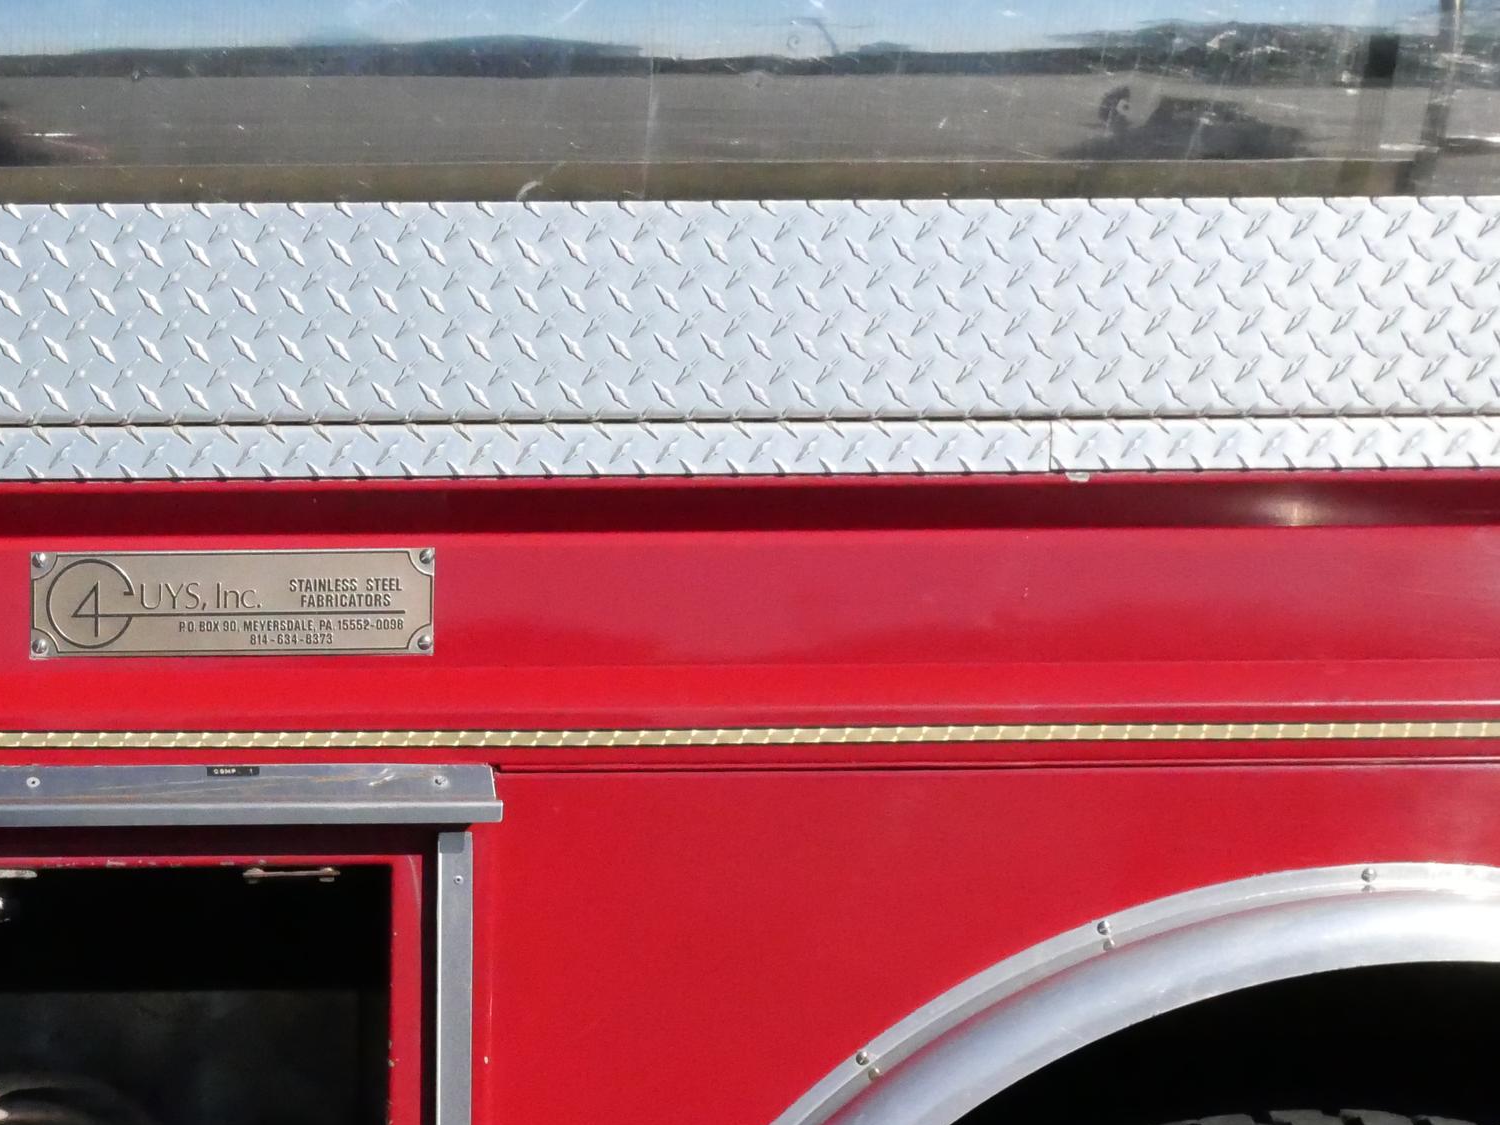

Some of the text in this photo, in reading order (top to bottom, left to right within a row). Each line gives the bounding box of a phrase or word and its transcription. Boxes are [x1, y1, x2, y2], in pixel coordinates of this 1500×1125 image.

[289, 578, 402, 592] STAINLESS STEEL
[216, 582, 262, 609] Inc.
[300, 593, 391, 607] FABRICATORS
[199, 620, 219, 632] BOX
[243, 619, 316, 632] MEYERSDALE,
